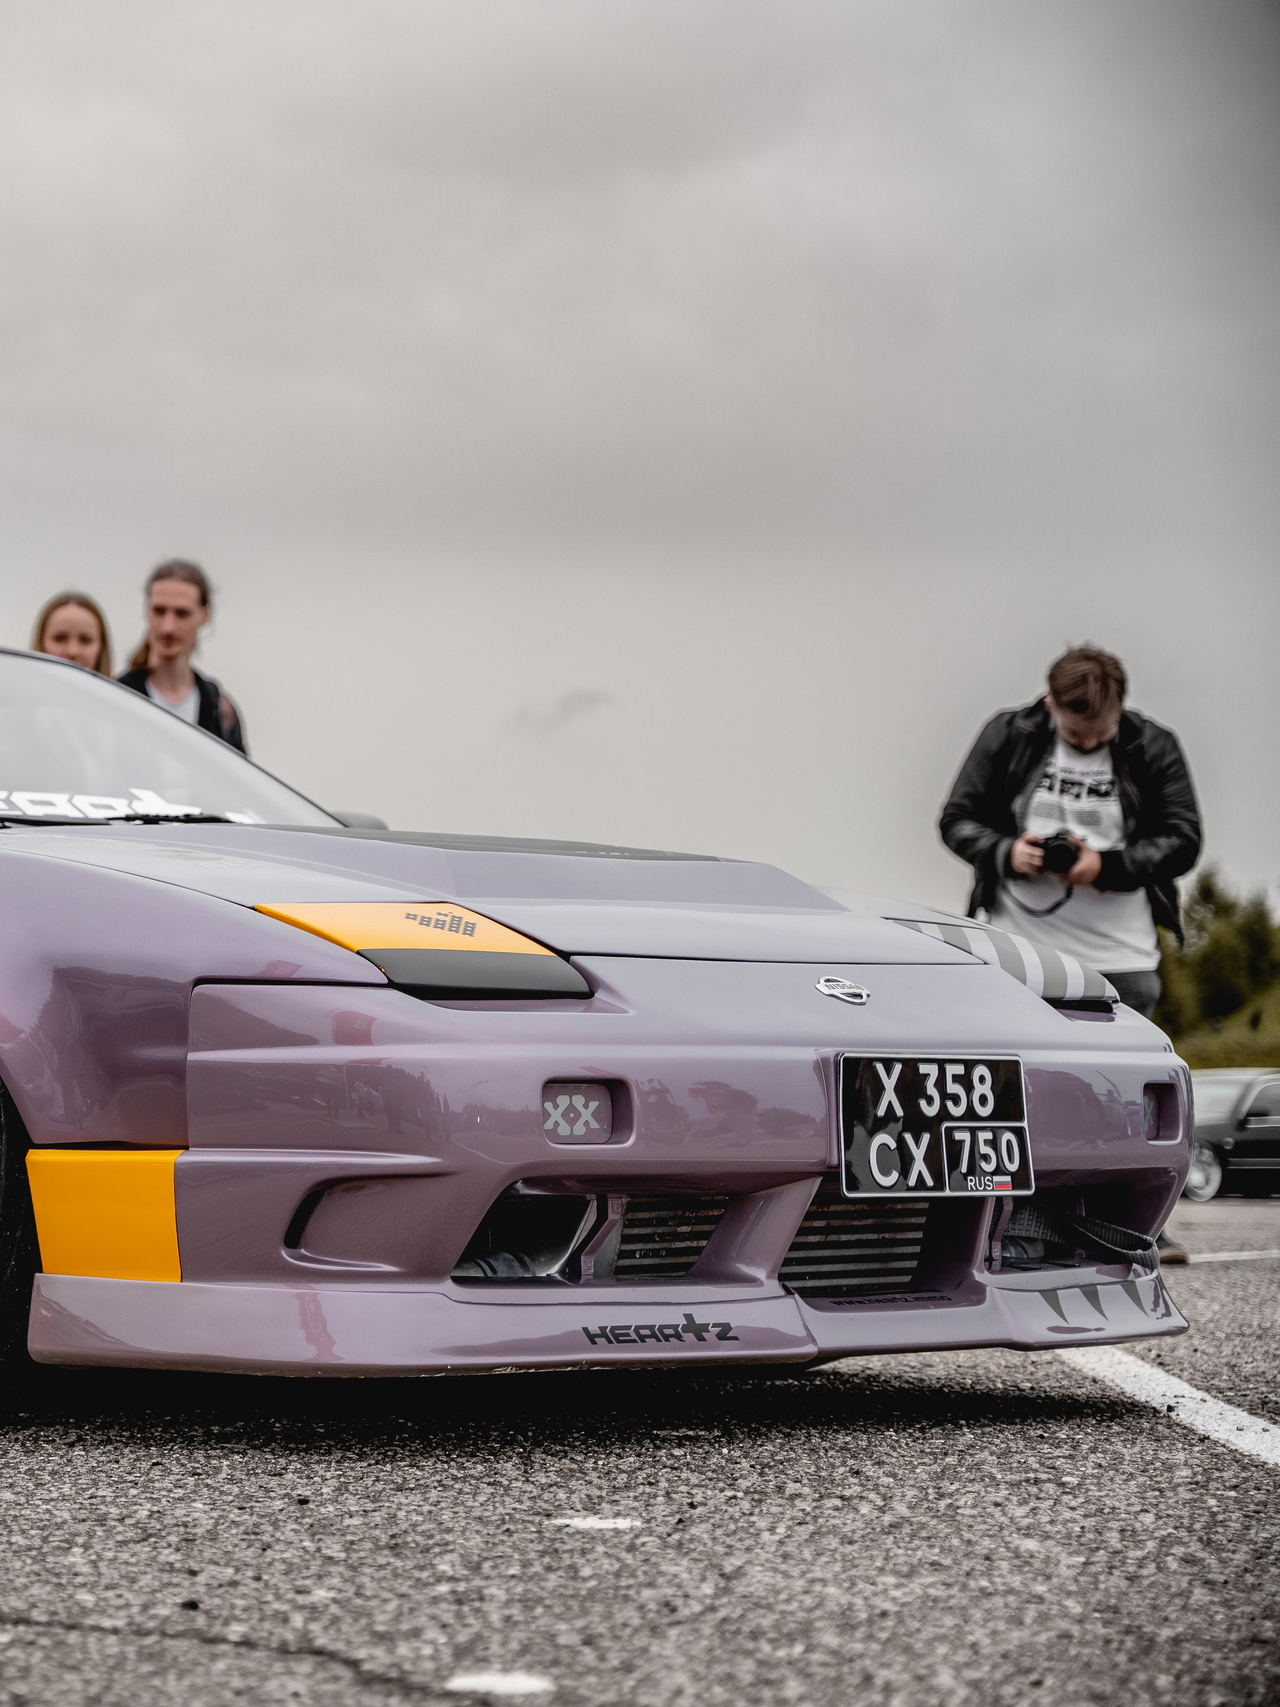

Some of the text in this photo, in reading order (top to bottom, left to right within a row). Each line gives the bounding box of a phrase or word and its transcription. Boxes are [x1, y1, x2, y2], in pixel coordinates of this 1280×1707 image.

[874, 1062, 995, 1118] X 358
[869, 1130, 1020, 1188] CX 750
[966, 1175, 993, 1191] RUS
[581, 1312, 741, 1346] HEARTZ
